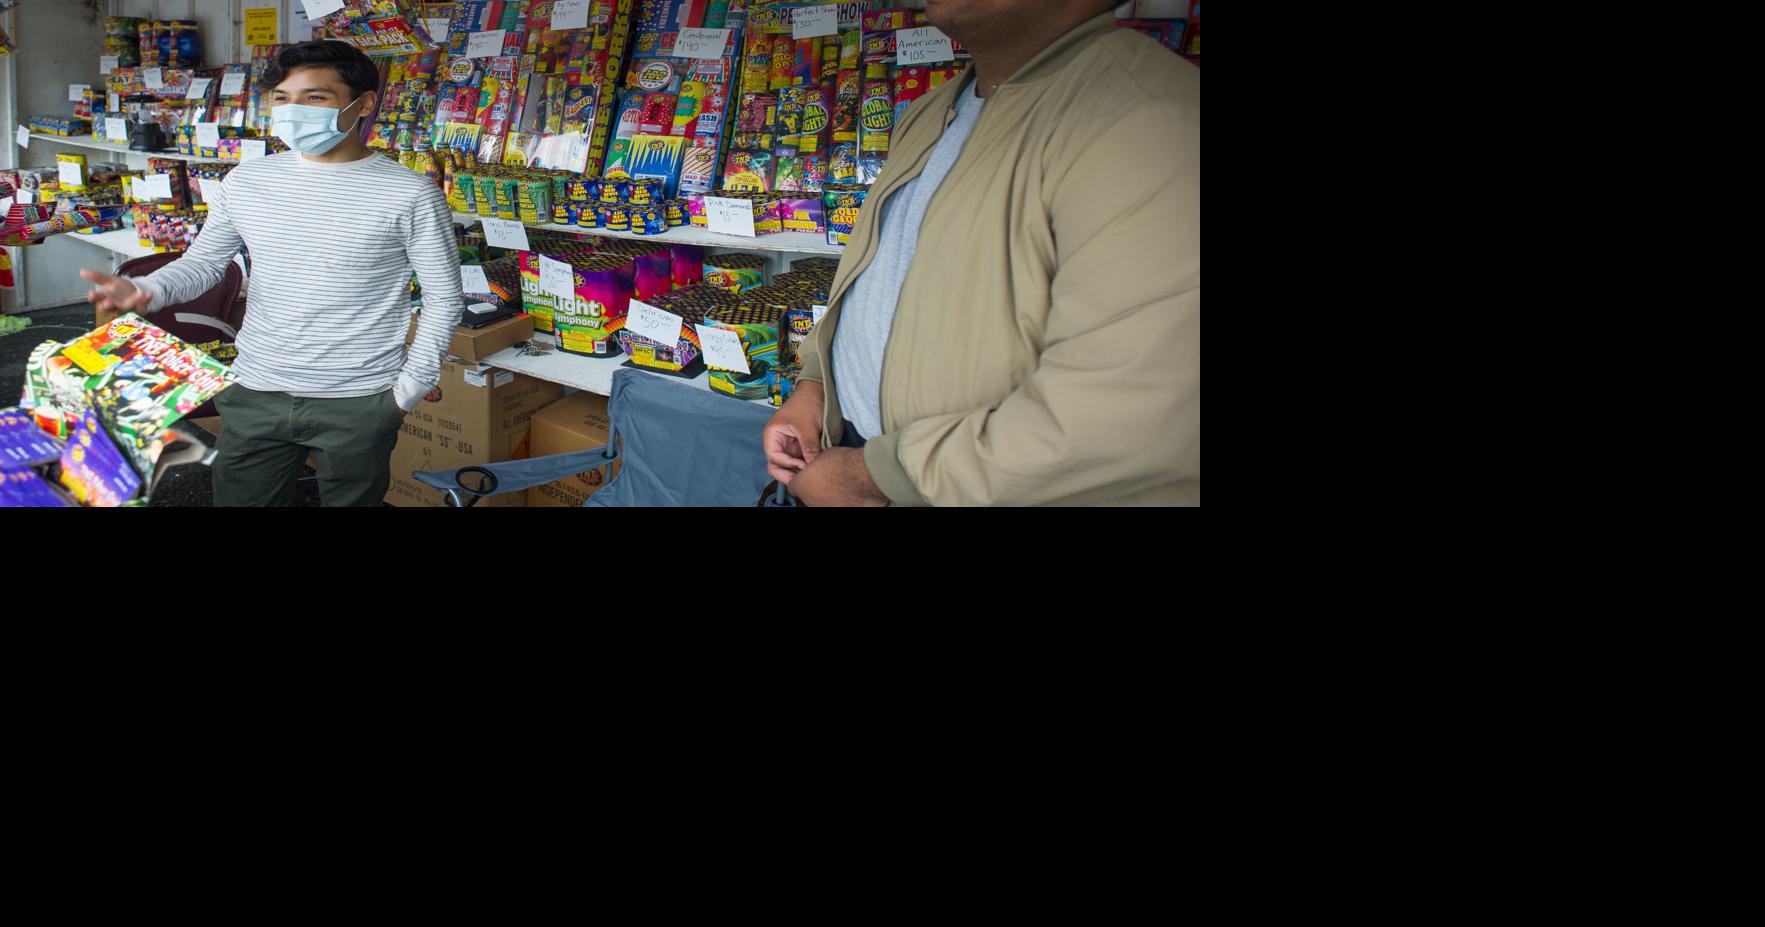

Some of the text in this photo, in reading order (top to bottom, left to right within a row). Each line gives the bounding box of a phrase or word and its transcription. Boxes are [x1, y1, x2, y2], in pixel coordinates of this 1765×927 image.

[682, 30, 721, 40] Centennial
[912, 29, 929, 38] All
[898, 39, 947, 49] American
[708, 198, 723, 206] Pink
[794, 320, 810, 330] TNT
